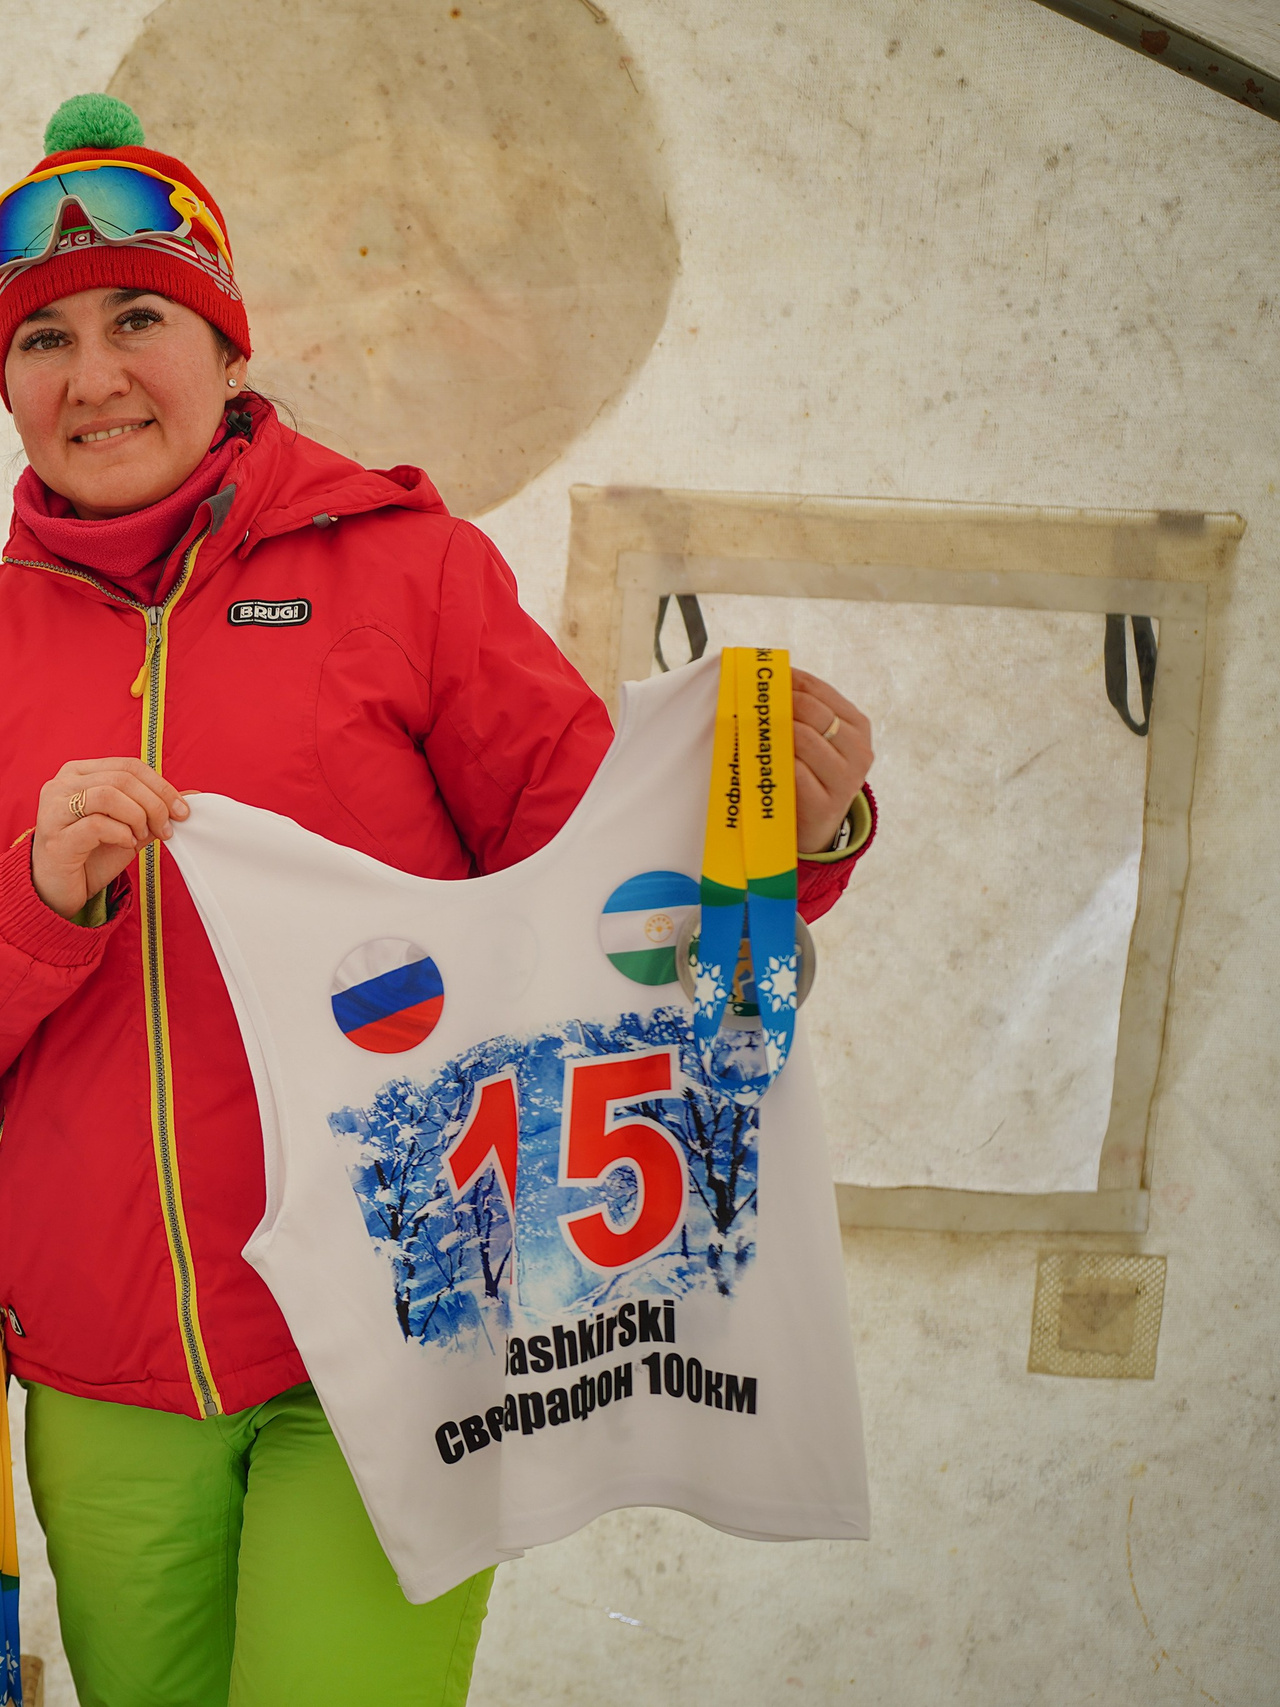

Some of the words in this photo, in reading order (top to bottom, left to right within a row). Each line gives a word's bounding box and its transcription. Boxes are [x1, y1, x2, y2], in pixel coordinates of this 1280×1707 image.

[239, 605, 299, 620] BRUGI
[753, 667, 777, 819] Сверхмарафон
[505, 1299, 676, 1376] ashkirSki
